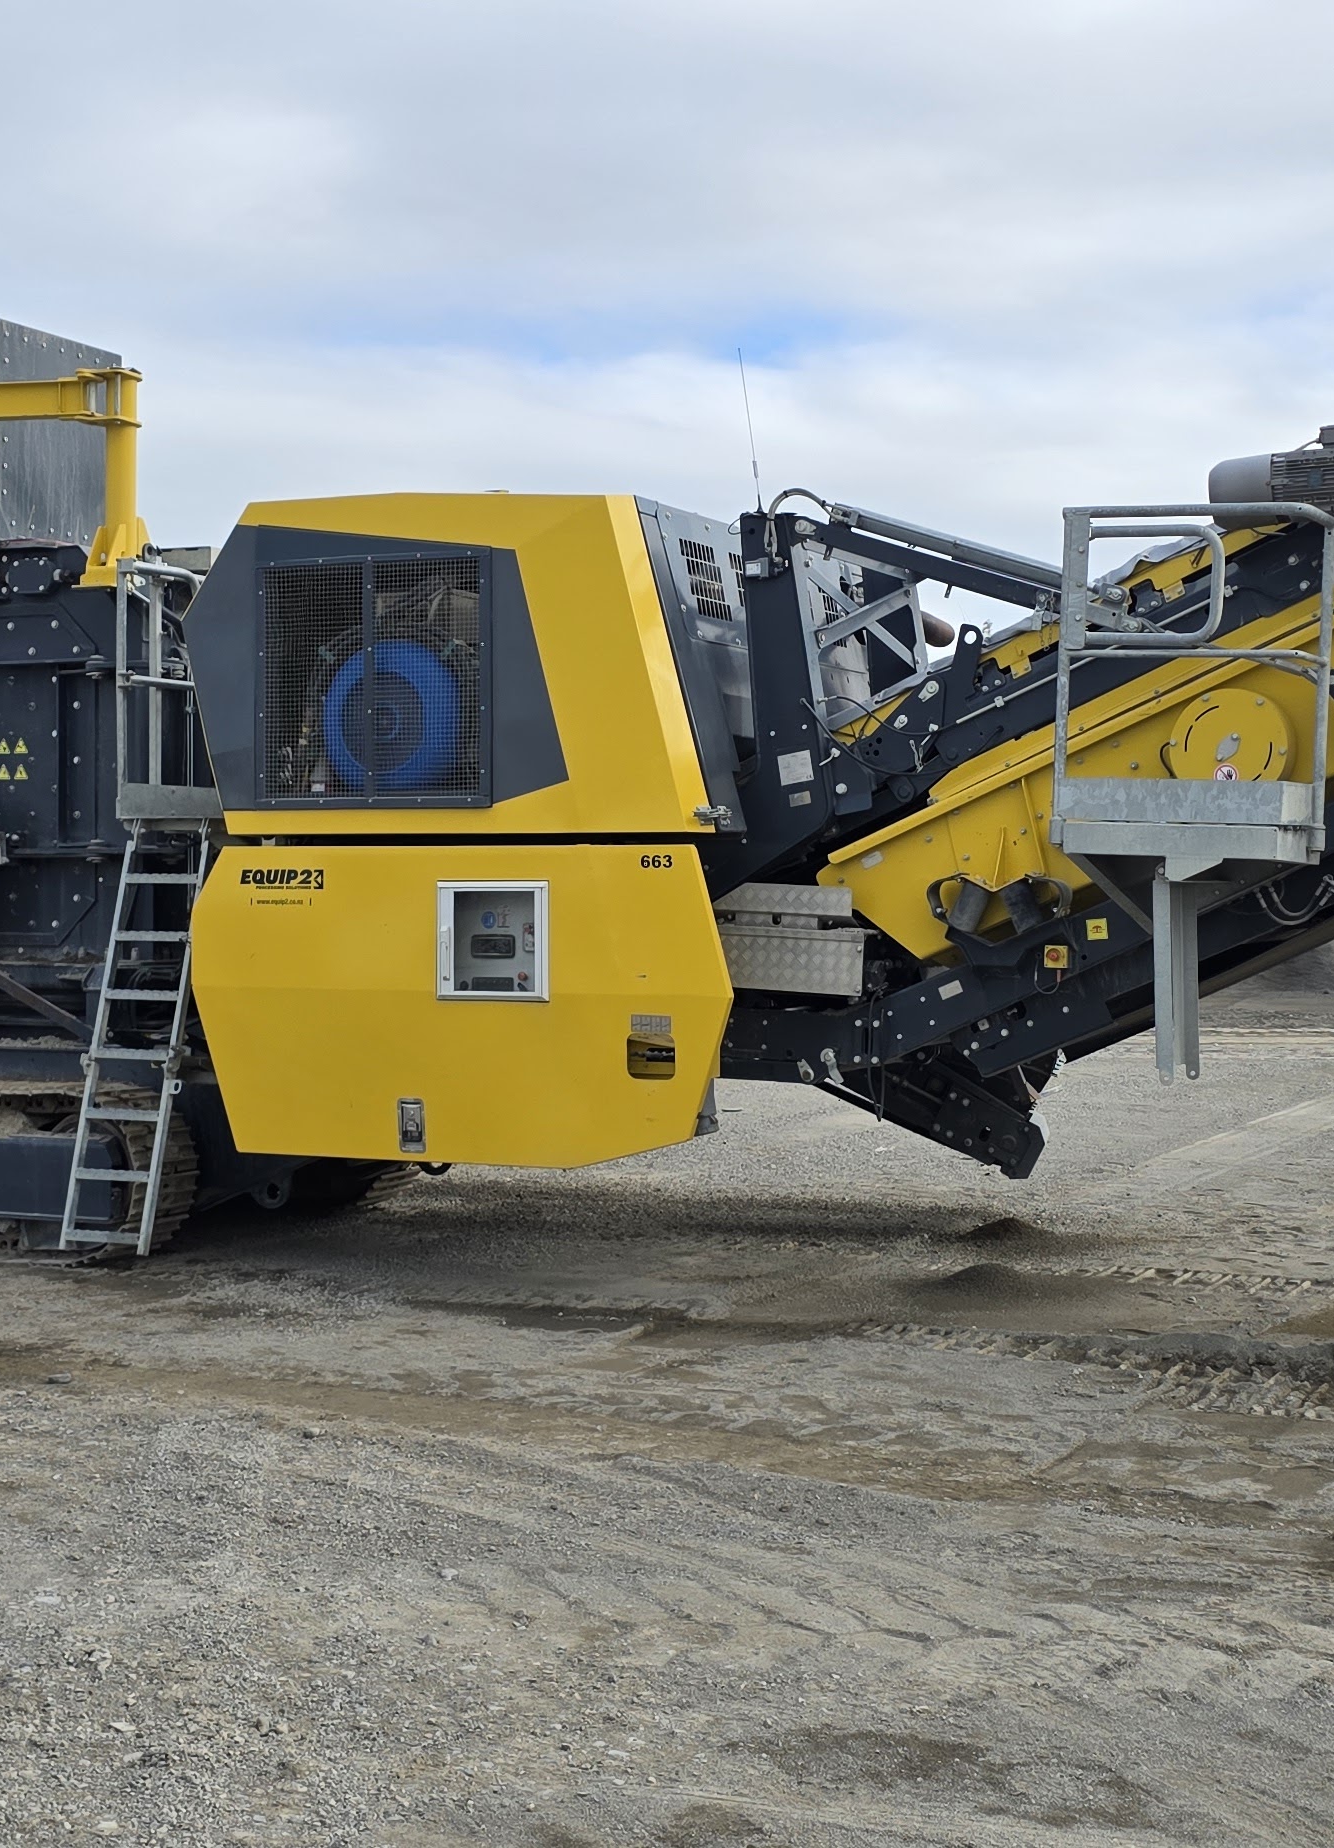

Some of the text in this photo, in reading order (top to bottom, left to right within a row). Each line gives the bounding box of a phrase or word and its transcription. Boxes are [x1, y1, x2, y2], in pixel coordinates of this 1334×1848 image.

[640, 854, 673, 869] 663
[240, 869, 313, 885] EQUIP2
[256, 898, 304, 906] www.equip2.co.nz
